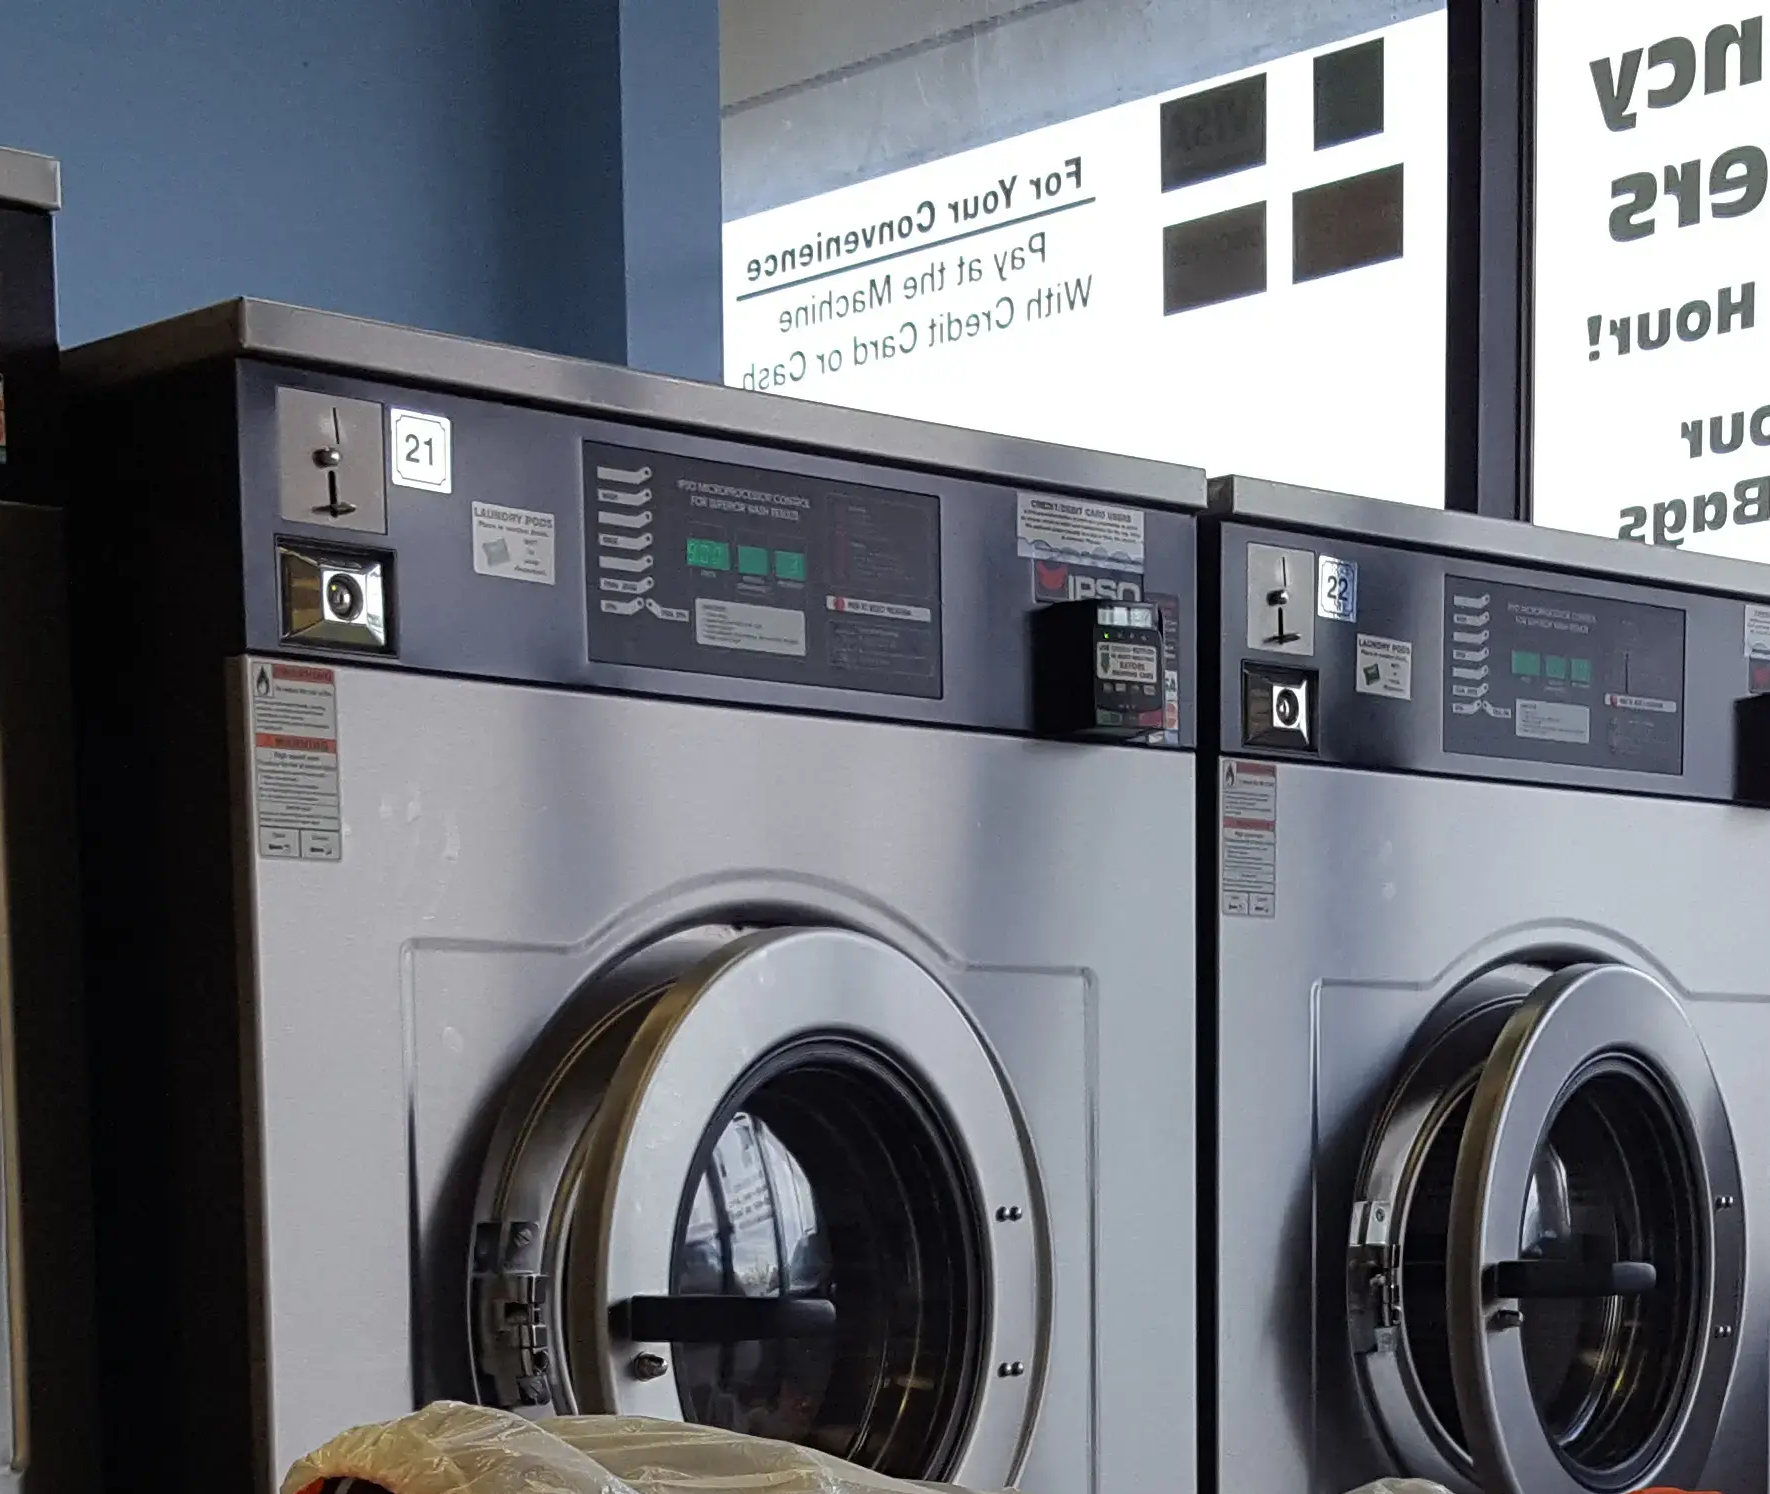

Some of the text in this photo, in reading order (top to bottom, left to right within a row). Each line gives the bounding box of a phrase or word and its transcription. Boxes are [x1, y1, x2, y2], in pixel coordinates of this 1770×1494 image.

[405, 433, 434, 466] 21
[474, 506, 521, 527] LAUNDRY
[1085, 508, 1106, 520] CARD
[1068, 574, 1142, 602] IPSO
[1327, 575, 1349, 601] 22
